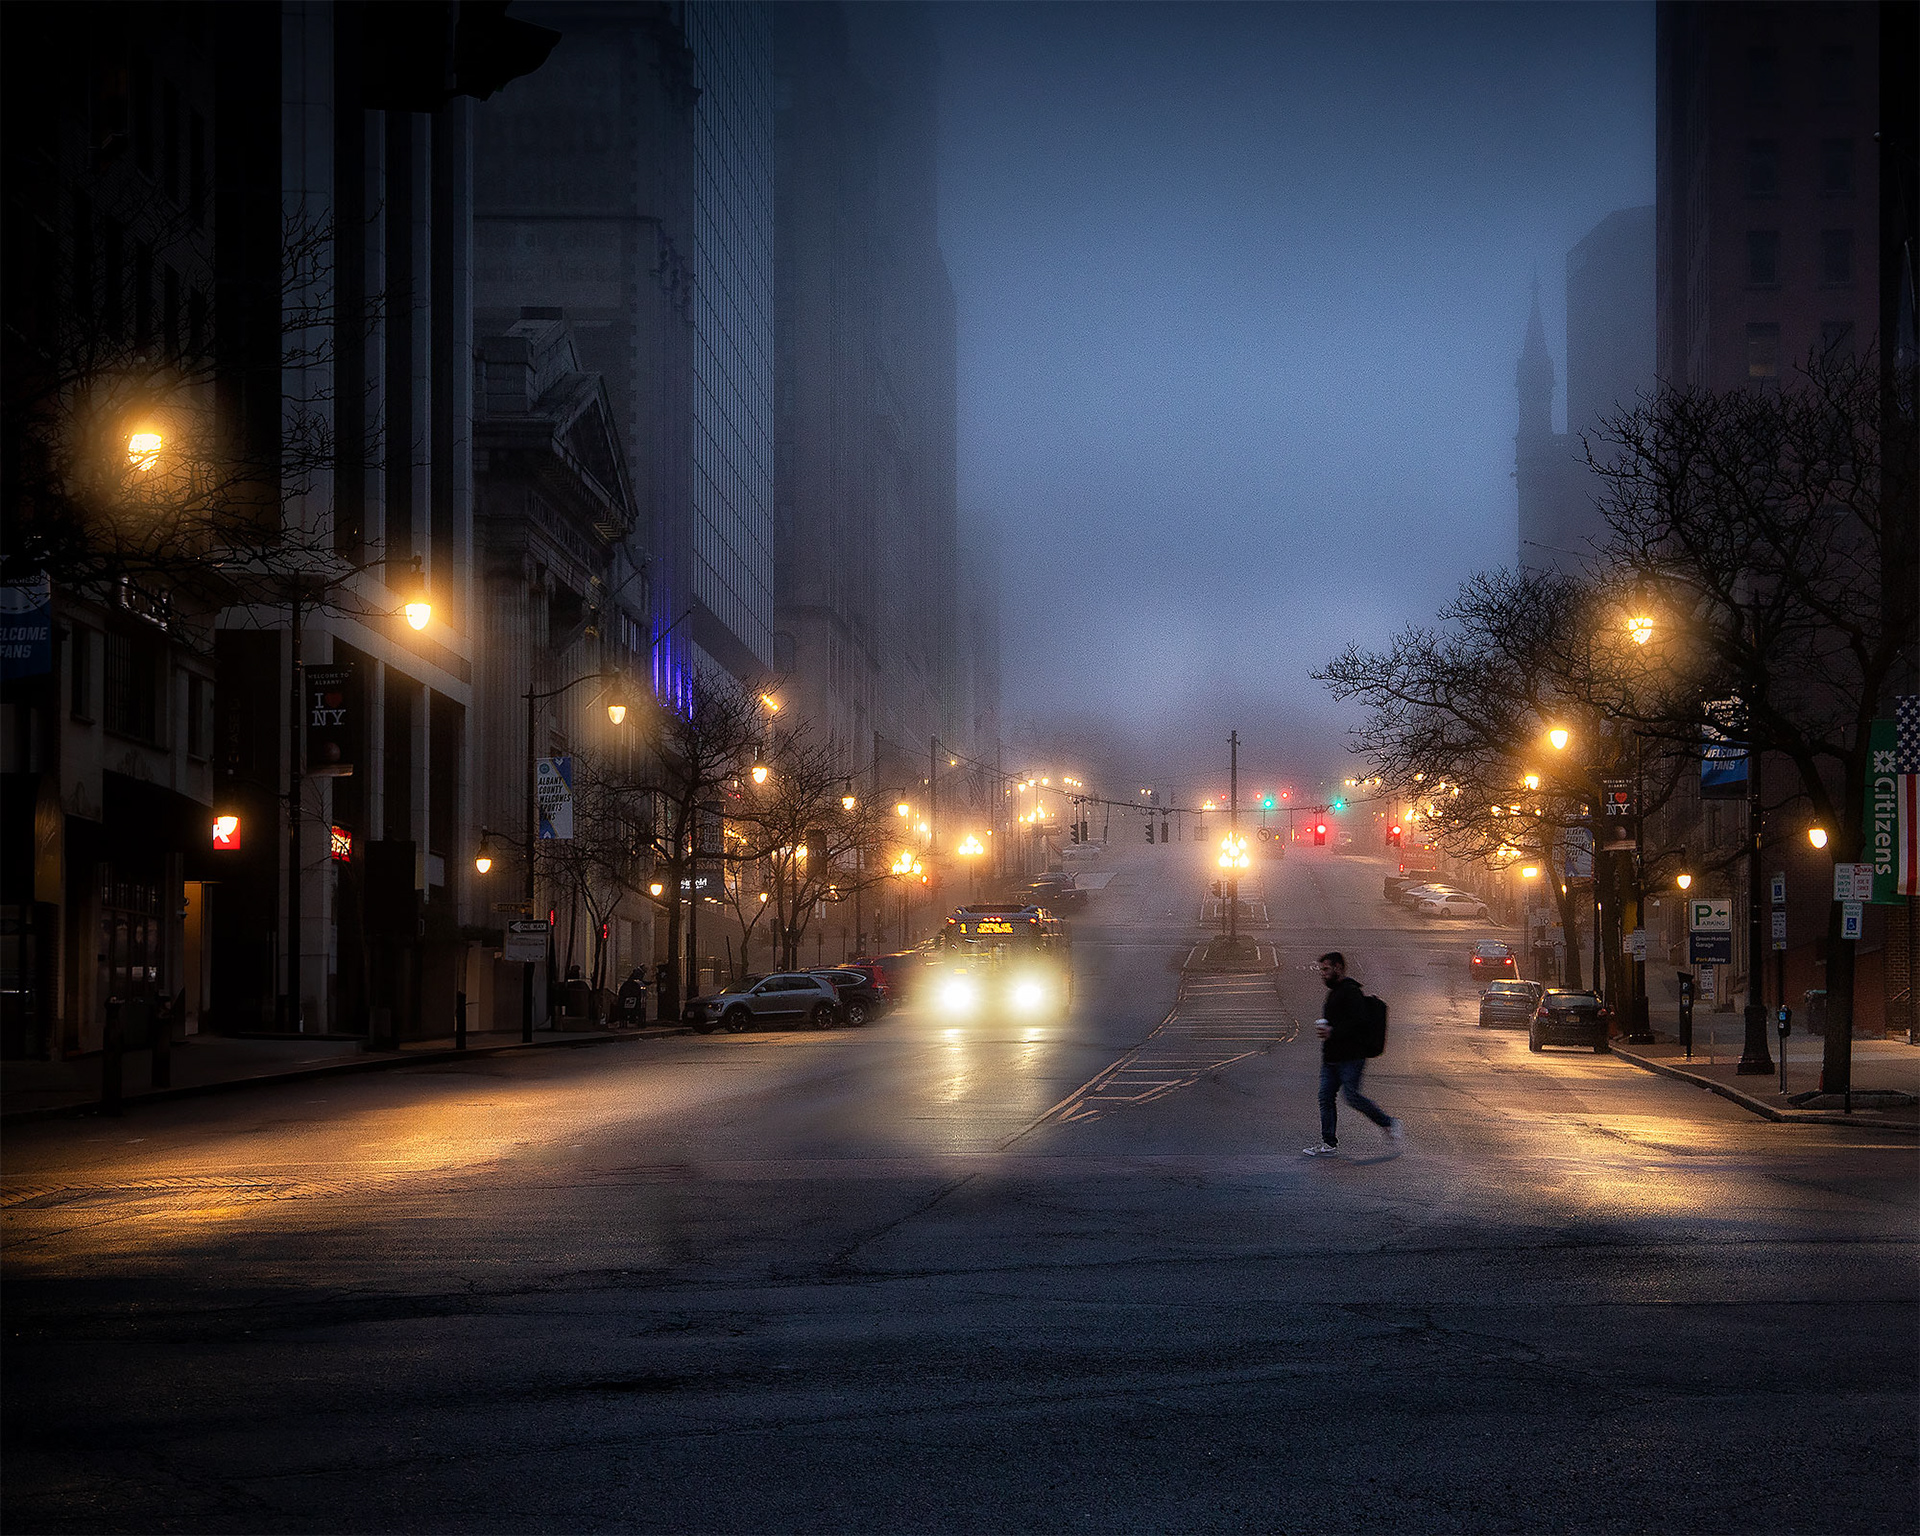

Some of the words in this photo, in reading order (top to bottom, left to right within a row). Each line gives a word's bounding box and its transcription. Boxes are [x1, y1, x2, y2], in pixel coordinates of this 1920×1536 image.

[0, 626, 49, 641] LCOME
[0, 645, 33, 659] FANS
[314, 692, 324, 709] I
[312, 709, 347, 726] NY
[1712, 760, 1736, 771] FANS
[538, 777, 563, 786] ALBANY
[538, 785, 563, 795] COUNTY
[539, 794, 572, 804] WELCOMES
[1608, 792, 1615, 804] I
[539, 803, 563, 812] SPORTS
[1606, 804, 1631, 815] NY
[1874, 777, 1896, 876] Citizens
[959, 922, 968, 934] 1
